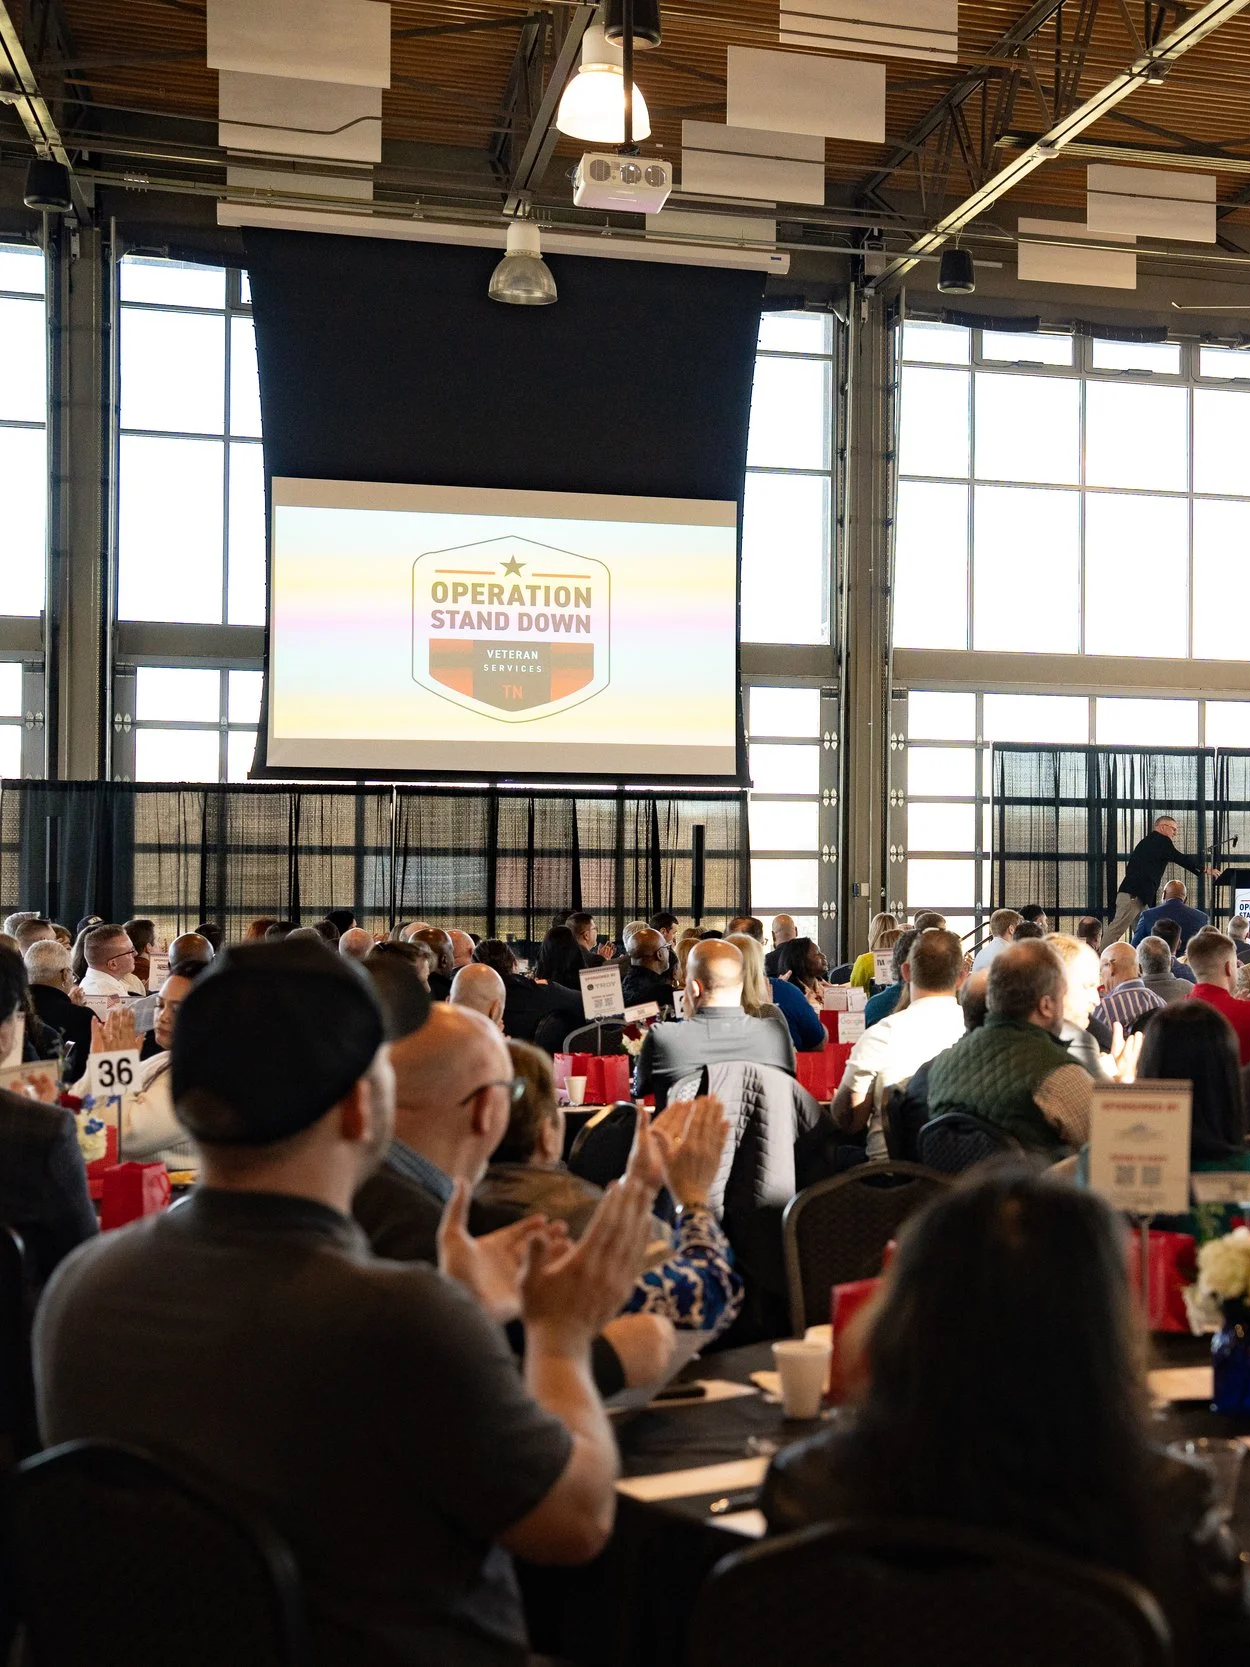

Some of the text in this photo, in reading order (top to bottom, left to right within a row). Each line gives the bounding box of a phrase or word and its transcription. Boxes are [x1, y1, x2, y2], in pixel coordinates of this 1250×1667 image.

[431, 581, 592, 608] OPERATION
[430, 609, 591, 634] STAND DOWN
[487, 649, 538, 660] VETERAN
[483, 664, 542, 673] SERVICES
[502, 684, 523, 699] TN
[595, 981, 616, 989] TROY
[98, 1058, 133, 1088] 36
